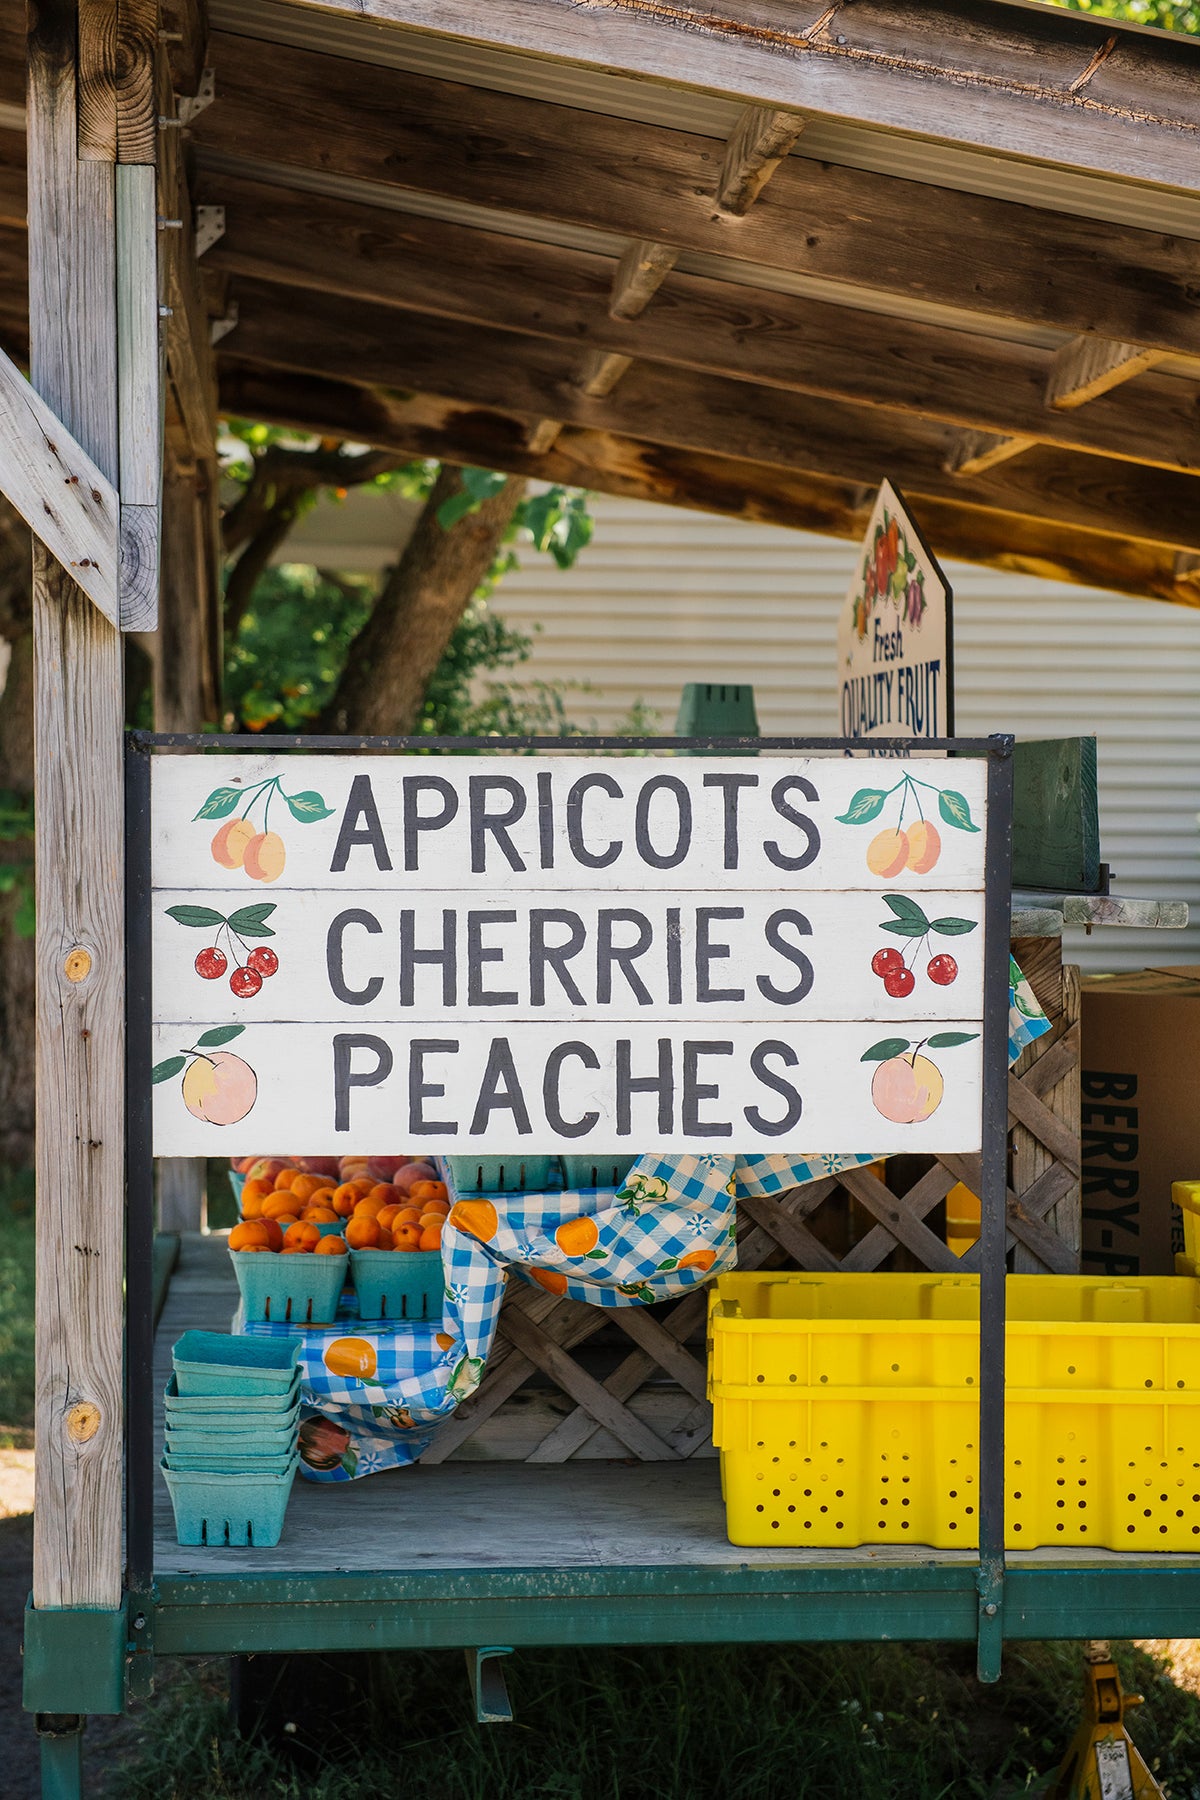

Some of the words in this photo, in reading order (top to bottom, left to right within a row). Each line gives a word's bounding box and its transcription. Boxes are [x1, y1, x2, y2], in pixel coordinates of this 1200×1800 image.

[873, 615, 904, 662] Fresh
[842, 670, 894, 738] QUALITY
[897, 659, 941, 738] FRUIT
[330, 772, 820, 873] APRICOTS
[327, 907, 814, 1006] CHERRIES
[333, 1034, 802, 1138] PEACHES
